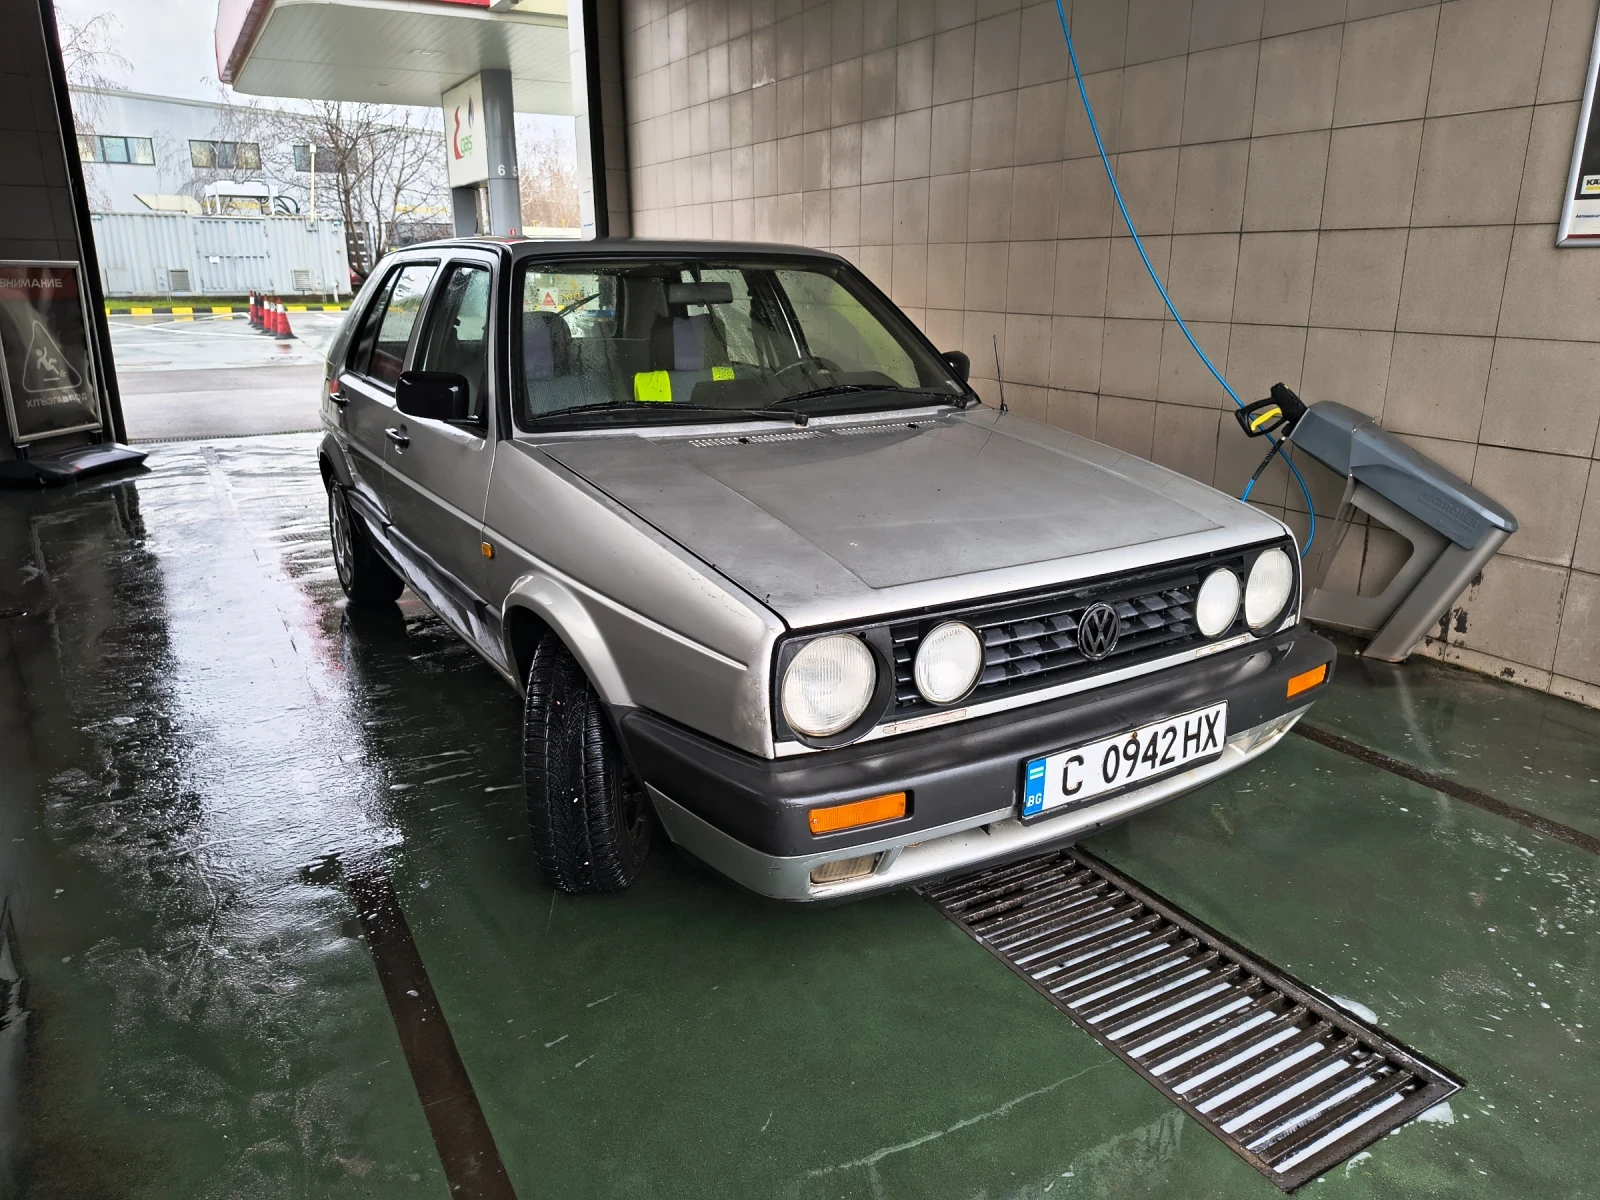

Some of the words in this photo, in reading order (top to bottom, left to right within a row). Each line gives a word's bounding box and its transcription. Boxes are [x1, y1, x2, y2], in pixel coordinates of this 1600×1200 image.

[498, 165, 506, 176] 6
[1062, 755, 1084, 796] C
[1027, 792, 1042, 807] BG
